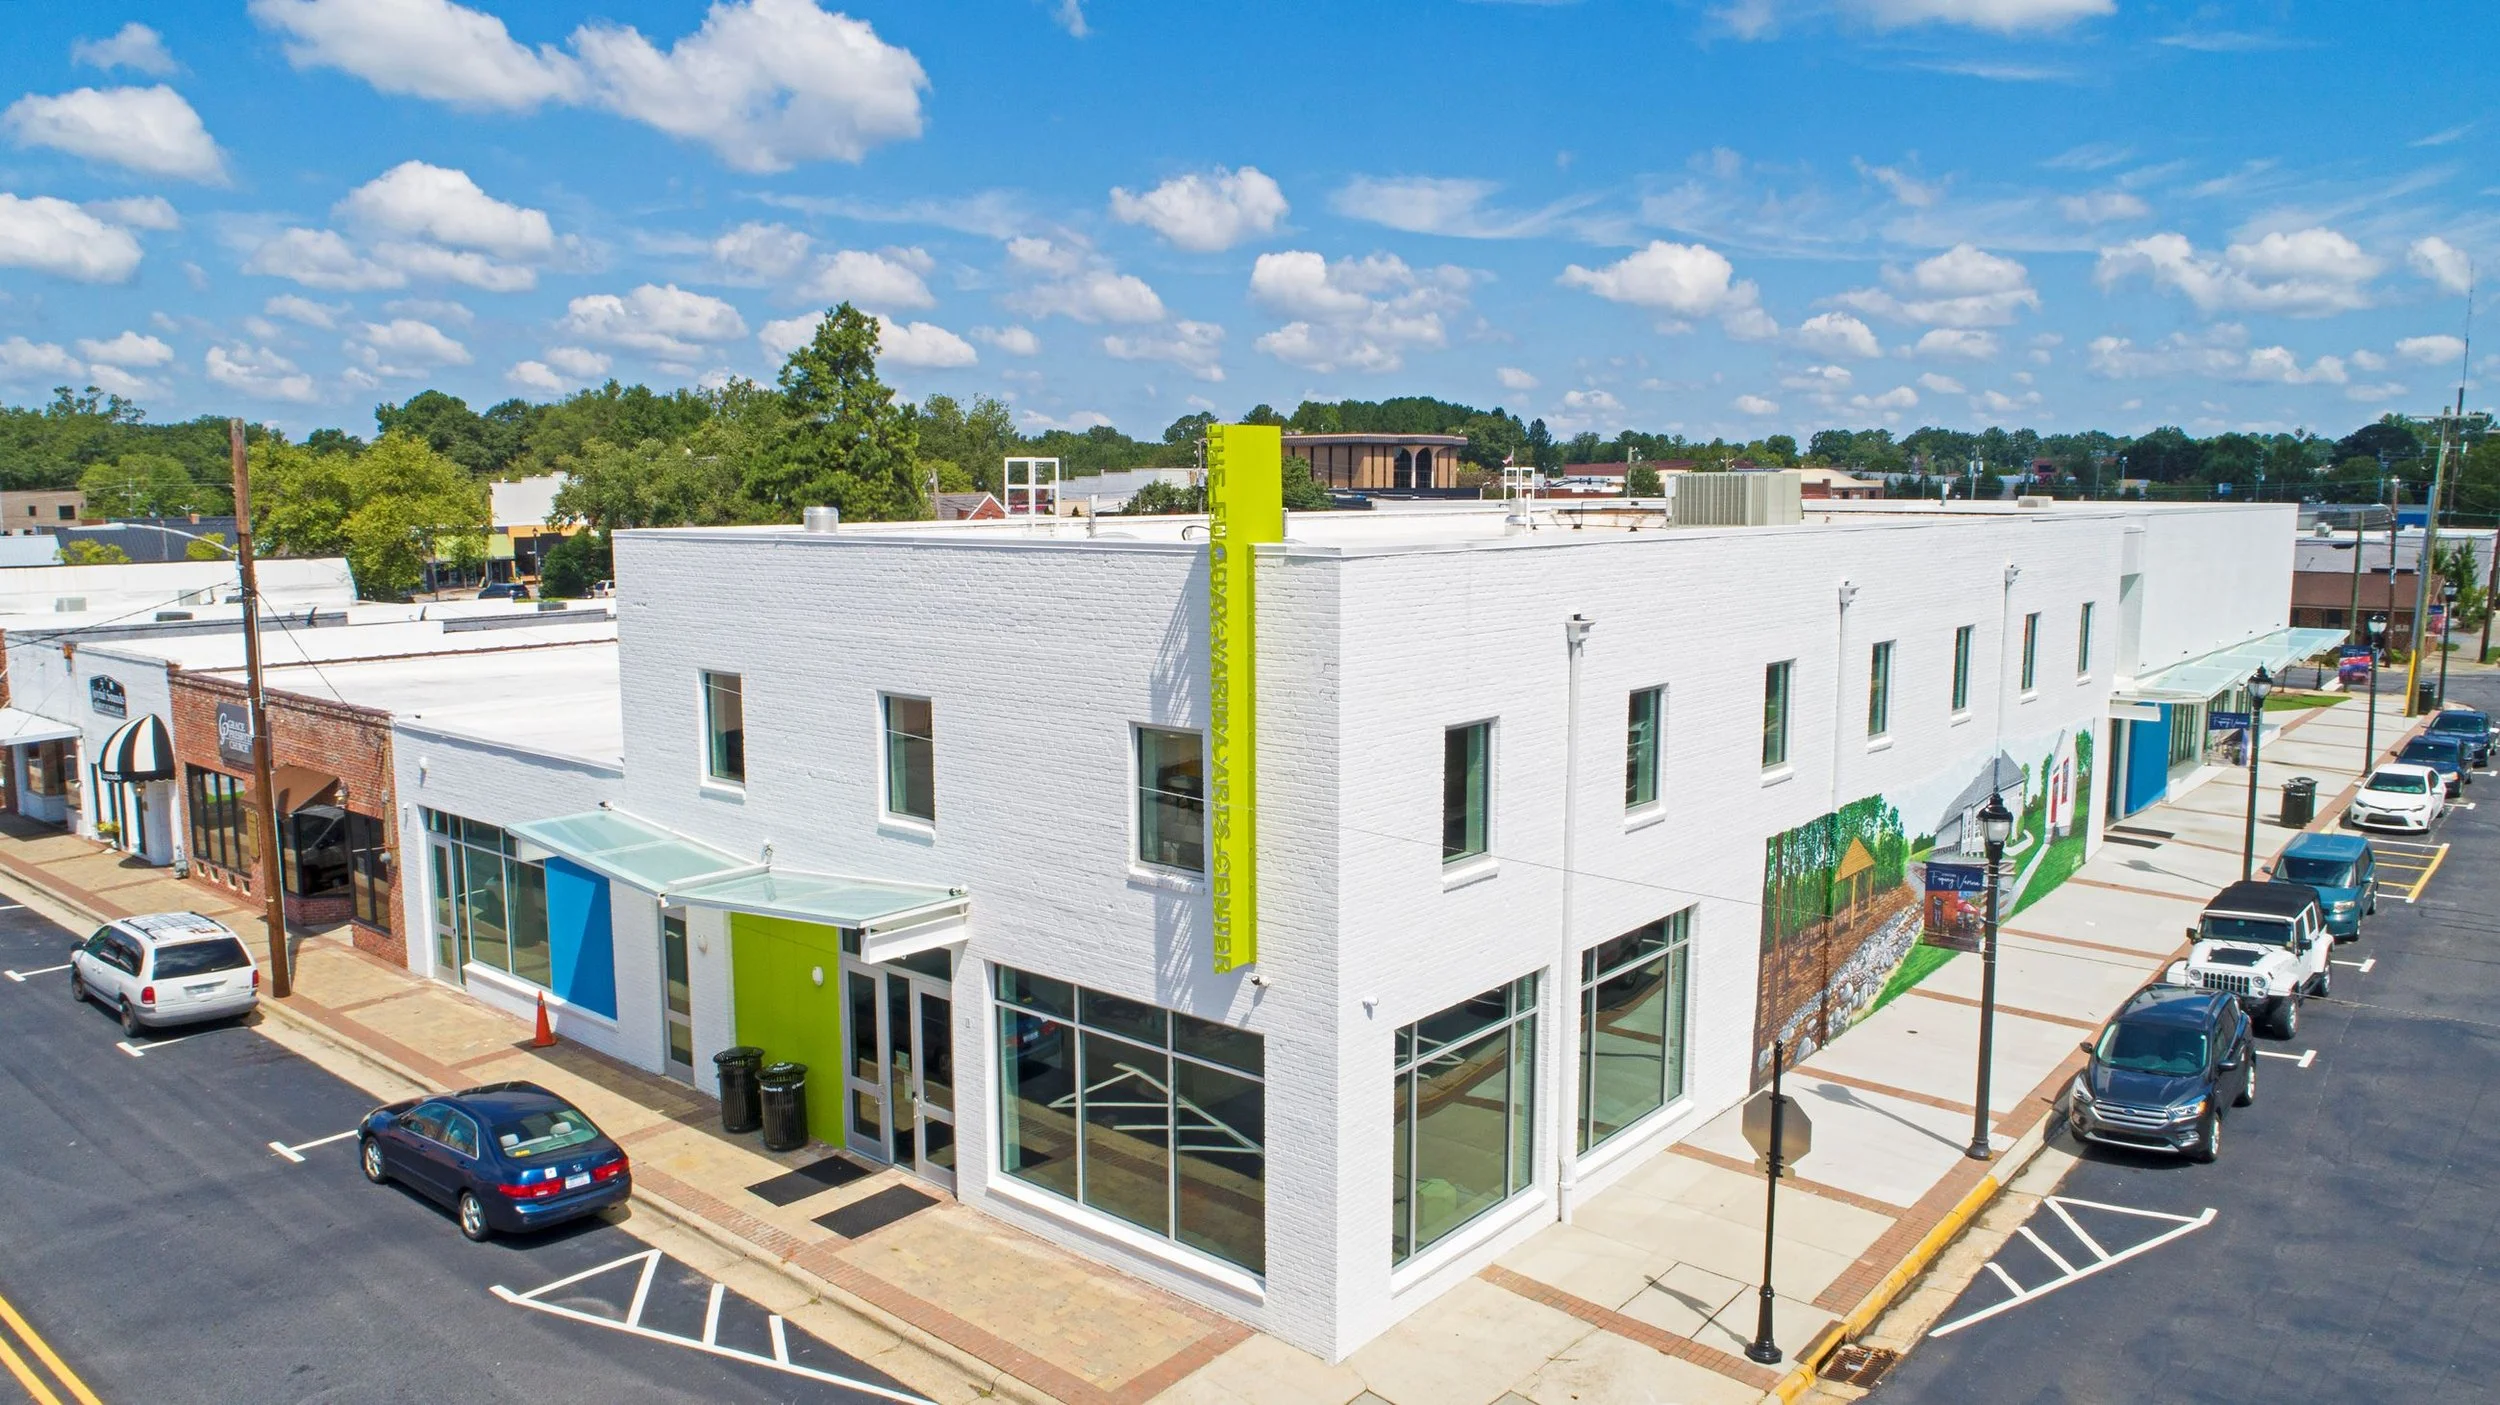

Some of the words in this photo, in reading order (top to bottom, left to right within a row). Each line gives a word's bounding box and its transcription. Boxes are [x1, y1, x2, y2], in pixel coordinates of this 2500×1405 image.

[1209, 425, 1226, 488] THE
[229, 720, 246, 731] GRACE
[229, 741, 250, 753] CHURCH
[1212, 760, 1230, 840] ARTS
[1213, 854, 1231, 974] CENTER
